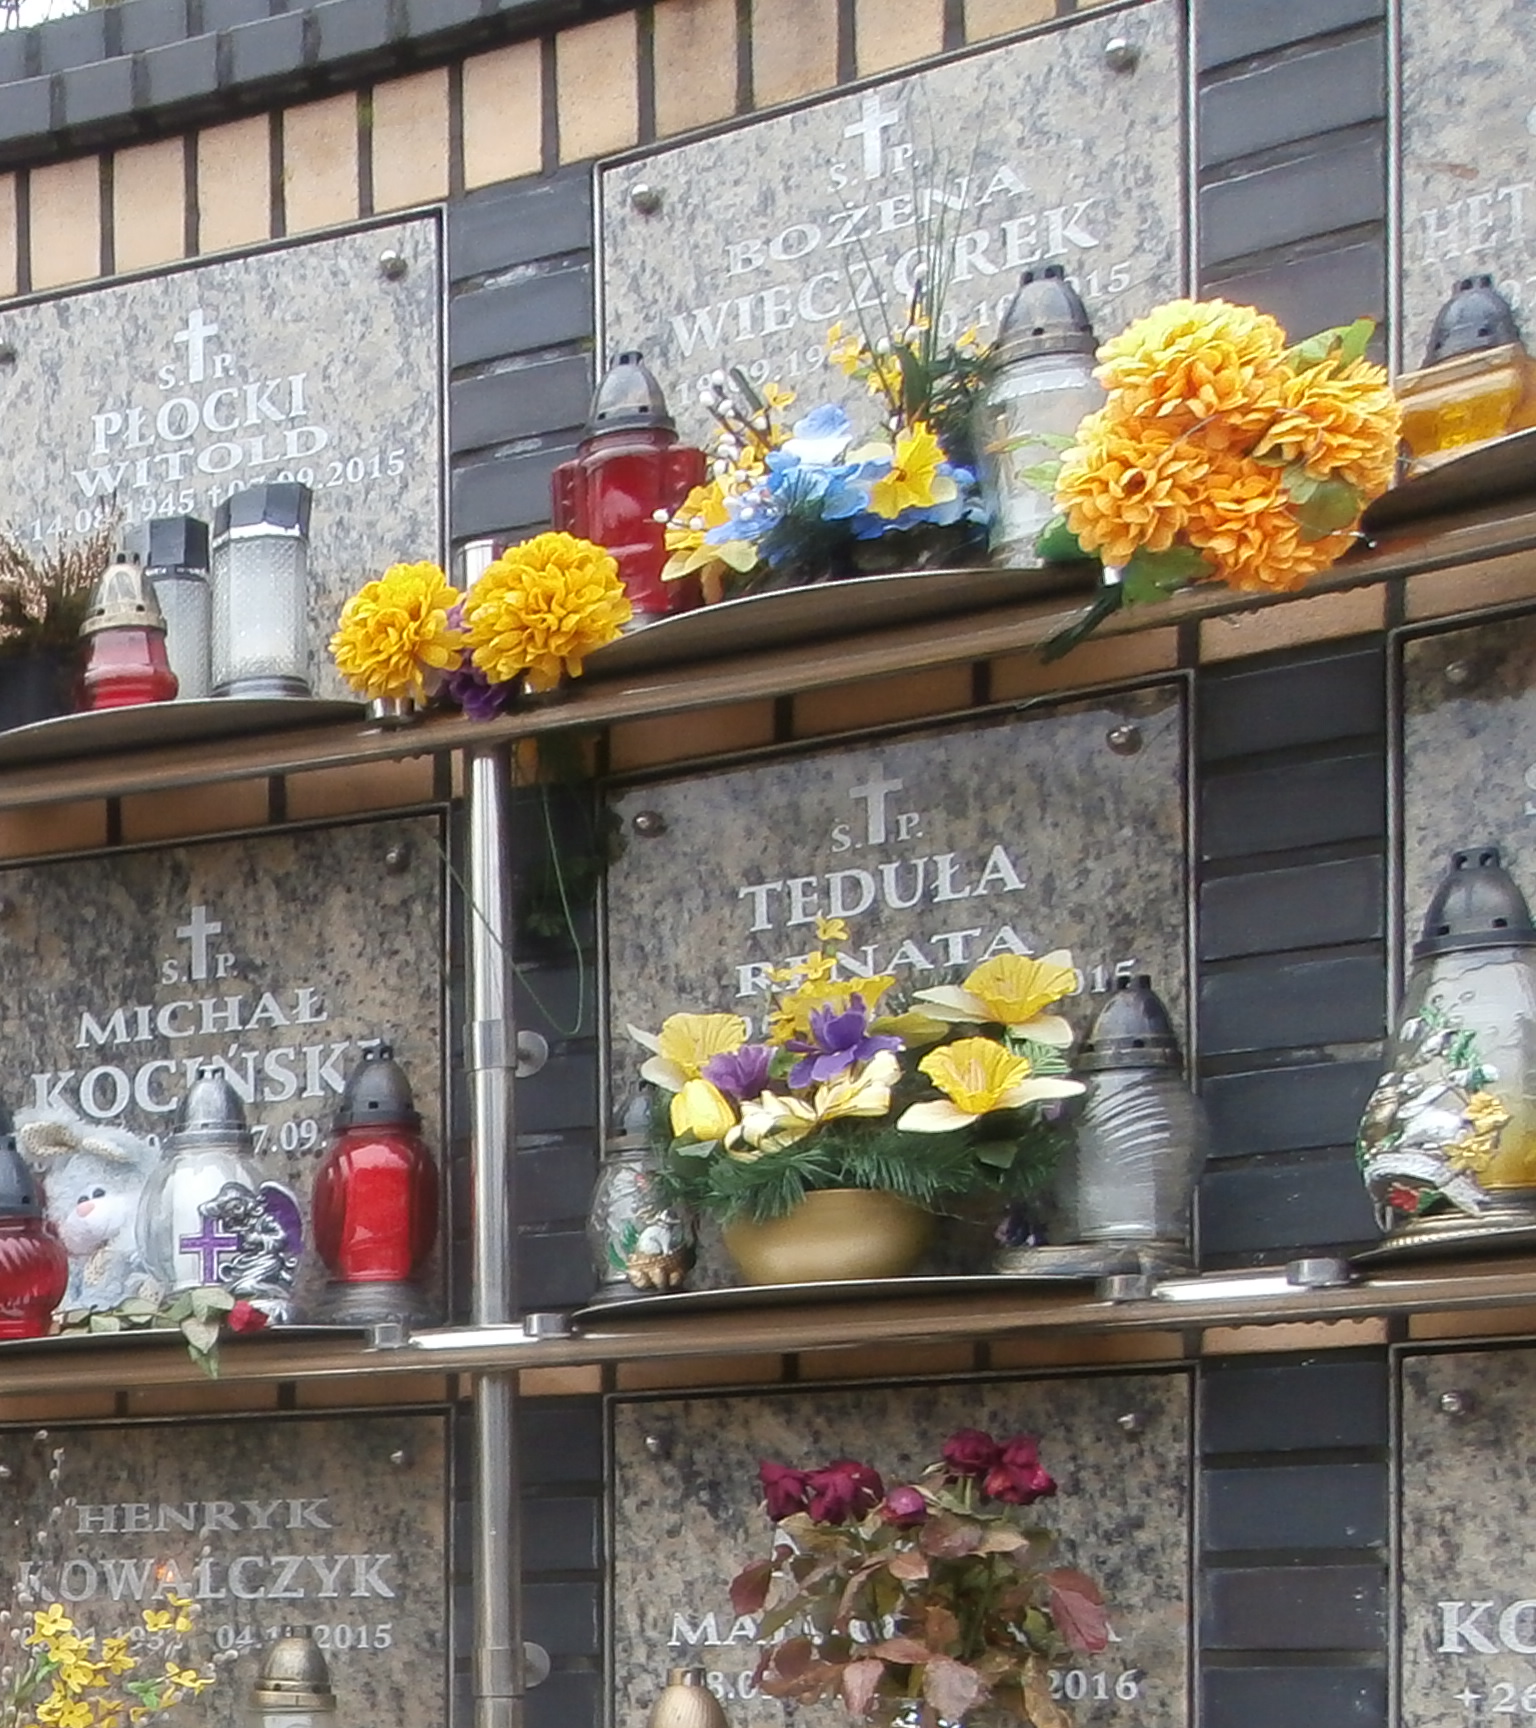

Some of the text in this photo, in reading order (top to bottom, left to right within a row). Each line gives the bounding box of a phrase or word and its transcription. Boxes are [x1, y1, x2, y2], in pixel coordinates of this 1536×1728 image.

[725, 164, 1032, 277] BOŻENA
[91, 373, 308, 456] PŁOCKI
[70, 426, 329, 498] WITOLD
[738, 844, 1026, 934] TEDUŁA
[75, 987, 328, 1049] MICHAŁ
[75, 1498, 333, 1534] HENRYK
[18, 1553, 396, 1602] KOWALCZYK
